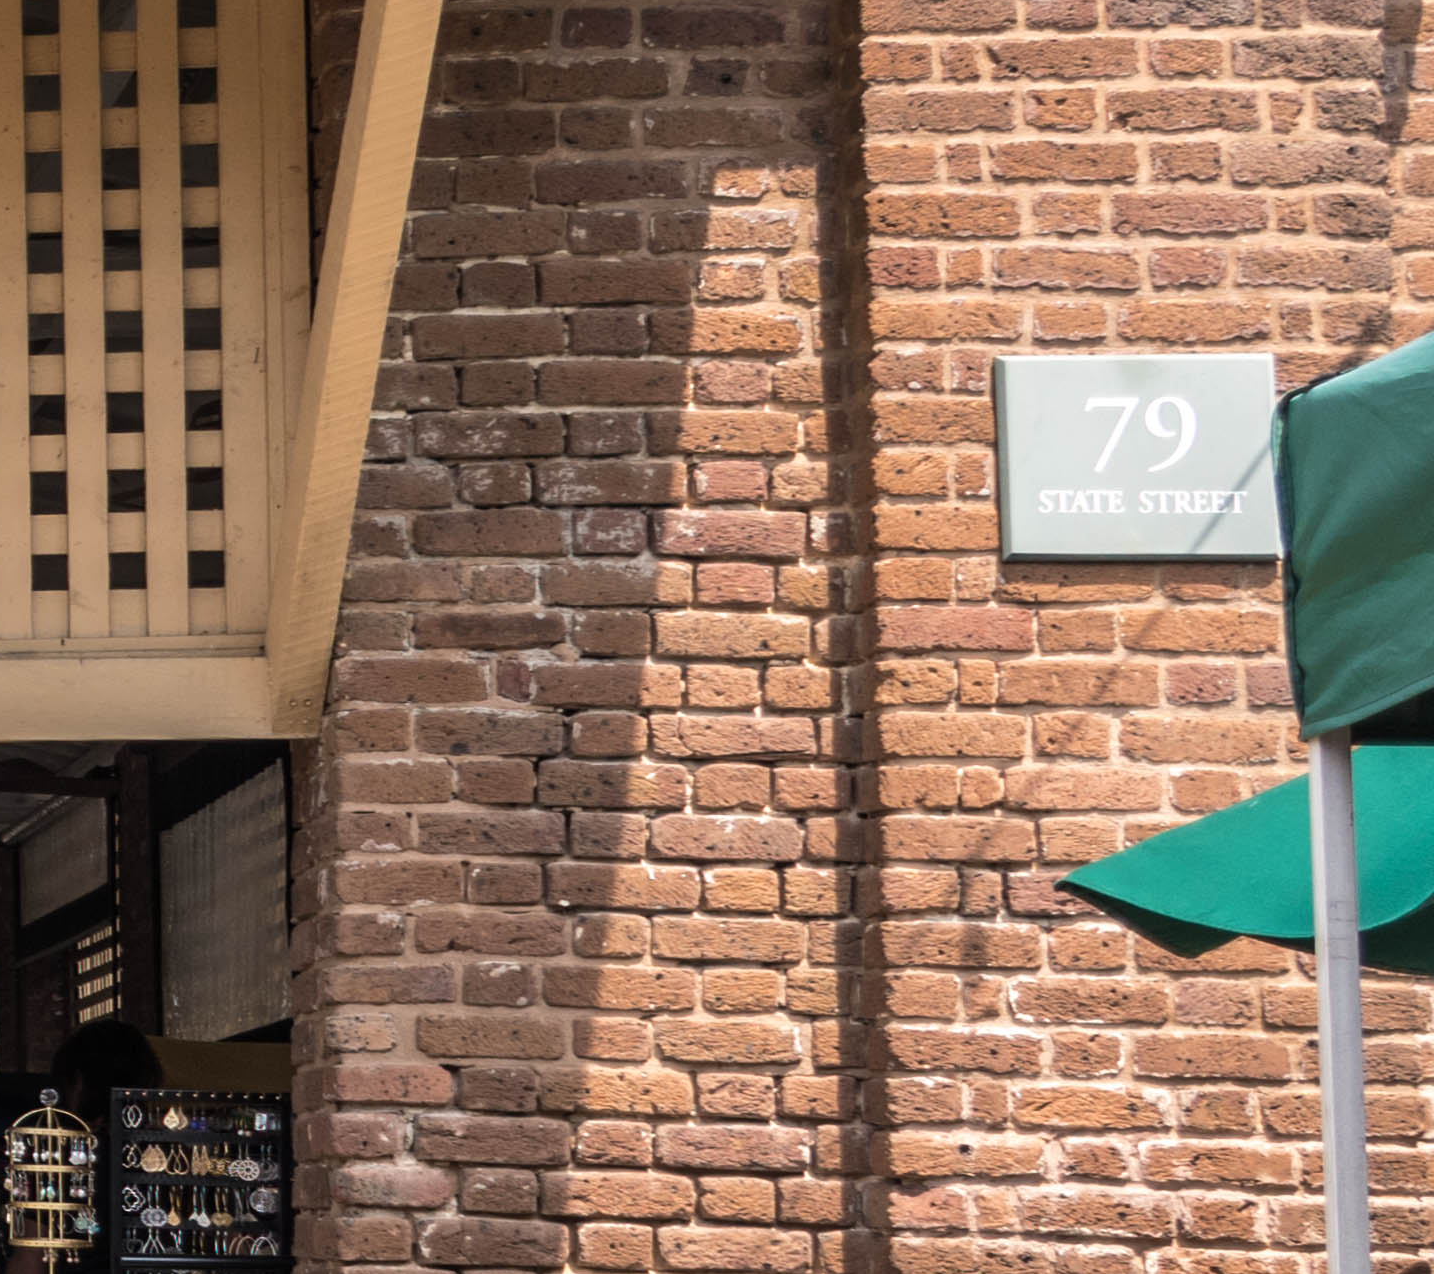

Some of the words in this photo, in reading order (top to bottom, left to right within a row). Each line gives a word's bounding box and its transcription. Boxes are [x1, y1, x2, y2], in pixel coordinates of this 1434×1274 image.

[1084, 395, 1197, 473] 79
[1037, 489, 1126, 514] STATE
[1138, 489, 1248, 515] STREET
